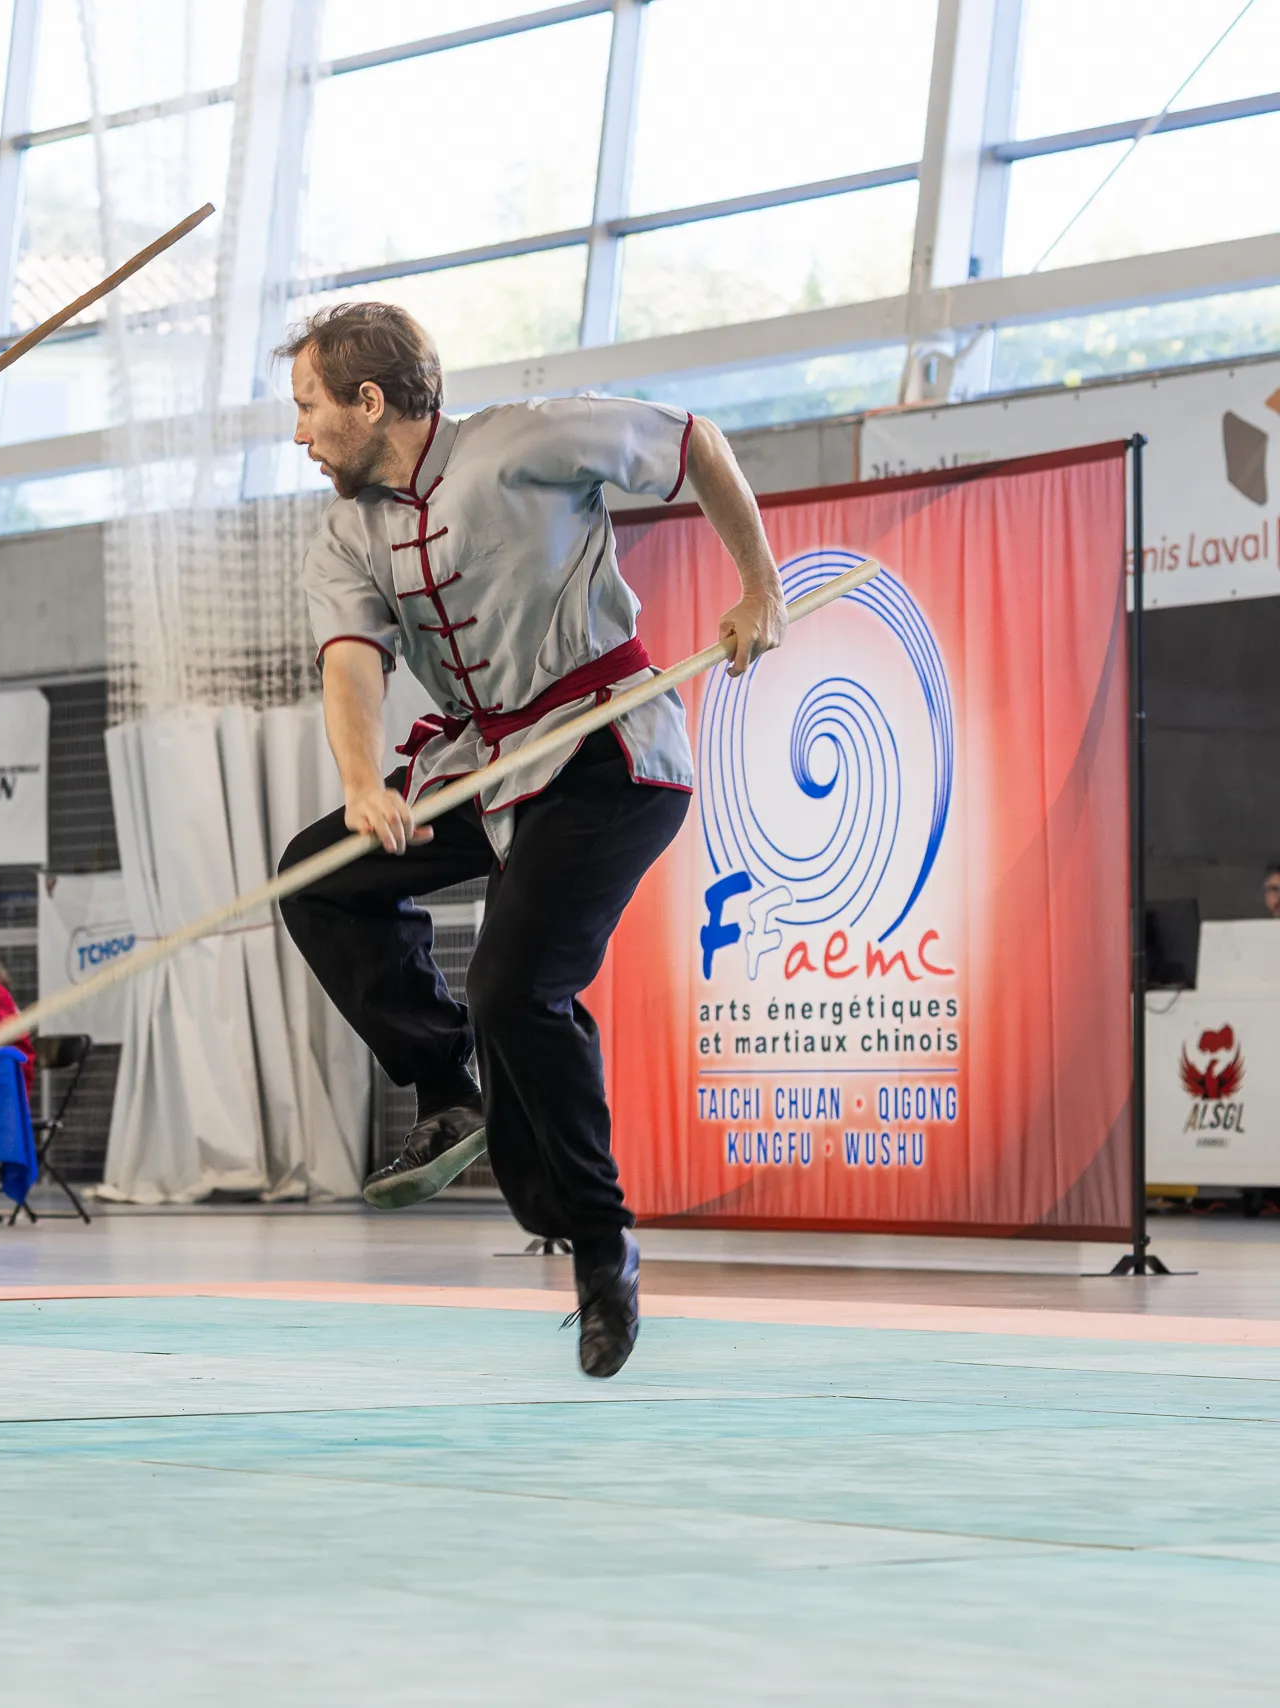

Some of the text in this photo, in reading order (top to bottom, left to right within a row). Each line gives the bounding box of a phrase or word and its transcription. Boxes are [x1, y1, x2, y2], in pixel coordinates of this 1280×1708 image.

[1187, 520, 1269, 568] Laval
[699, 995, 958, 1025] arts énergétiques
[699, 1027, 958, 1055] et martiaux chinois
[697, 1086, 958, 1122] TAICHI CHUAN QIGONG
[1183, 1101, 1246, 1135] ALSGL
[727, 1132, 925, 1167] KUNGFU WUSHU
